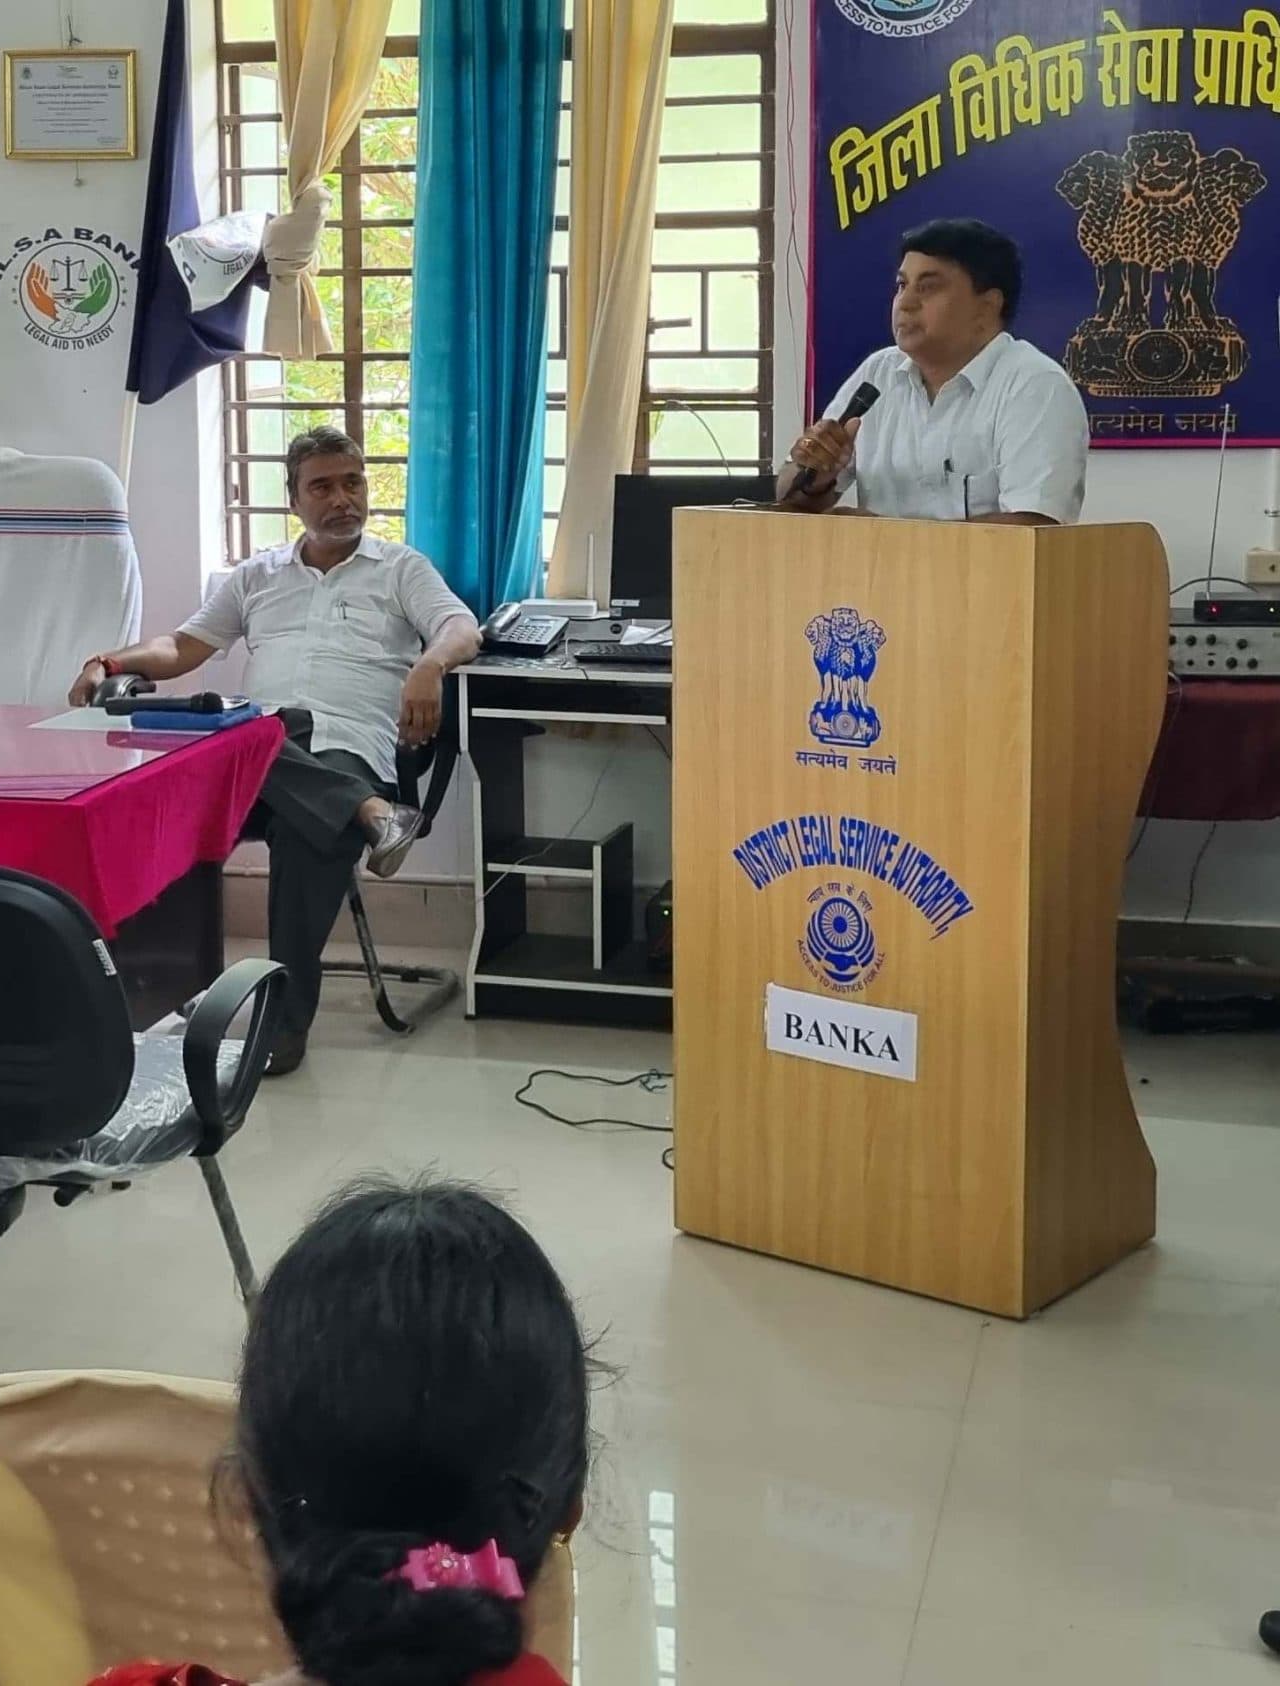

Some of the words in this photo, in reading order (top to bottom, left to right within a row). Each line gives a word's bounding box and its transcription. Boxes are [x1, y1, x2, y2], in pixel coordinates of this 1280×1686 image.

[865, 18, 884, 32] TO
[886, 14, 945, 36] JUSTICE
[830, 94, 941, 230] जिला
[949, 36, 1086, 156] विधिक
[1096, 10, 1183, 107] सेवा
[23, 322, 50, 346] LEGAL
[51, 338, 70, 351] AID
[72, 339, 85, 350] TO
[85, 324, 116, 346] NEEDY
[1089, 405, 1165, 433] त्यमेव
[795, 748, 848, 770] सत्यमेव
[859, 755, 896, 775] जयते
[733, 819, 797, 891] DISTRICT
[791, 815, 836, 867] LEGAL
[839, 815, 900, 882] SERVICE
[888, 842, 974, 941] AUTHORITY
[832, 981, 864, 993] JUSTICE
[784, 1011, 900, 1062] BANKA
